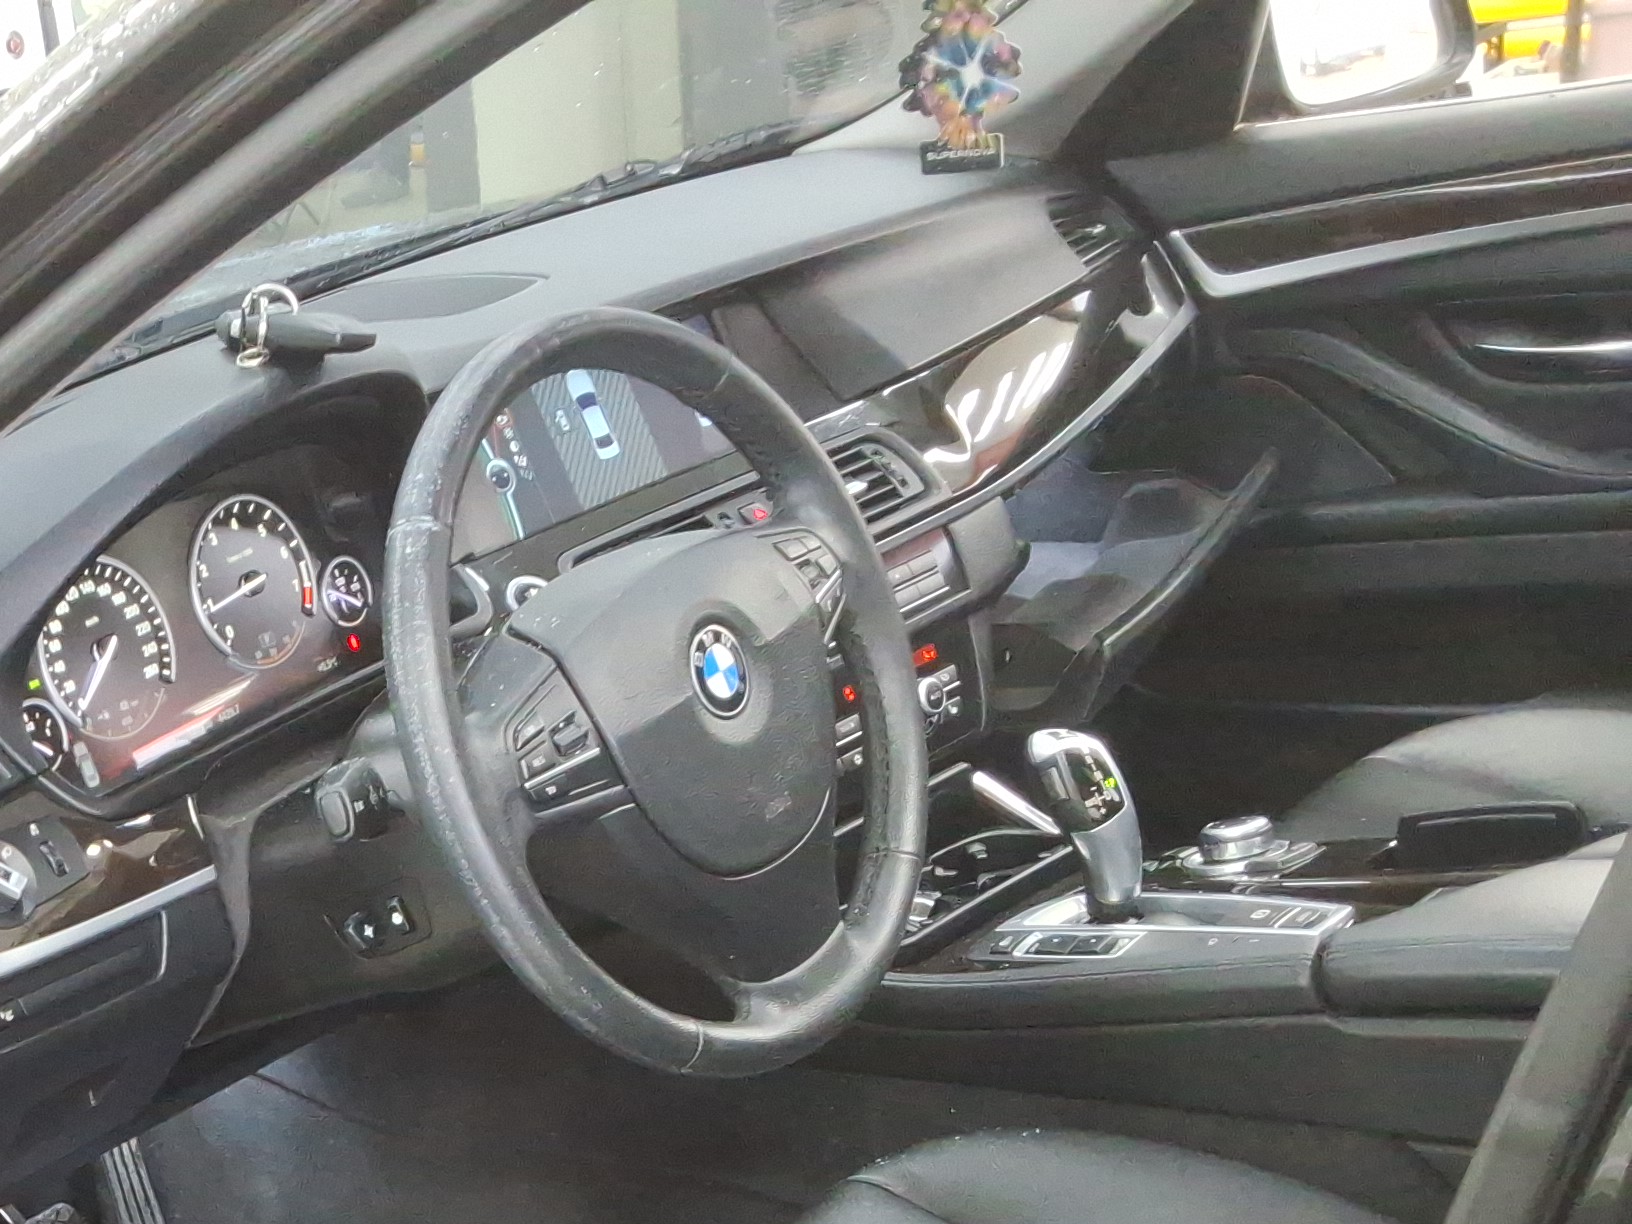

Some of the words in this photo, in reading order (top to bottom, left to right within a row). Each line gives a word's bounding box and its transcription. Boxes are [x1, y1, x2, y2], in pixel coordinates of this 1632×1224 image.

[927, 147, 996, 161] SUPERNOVA
[258, 523, 268, 538] 5
[209, 532, 218, 546] 3
[280, 546, 290, 560] 6
[199, 564, 210, 578] 2
[135, 620, 152, 636] 220
[224, 625, 235, 639] 0
